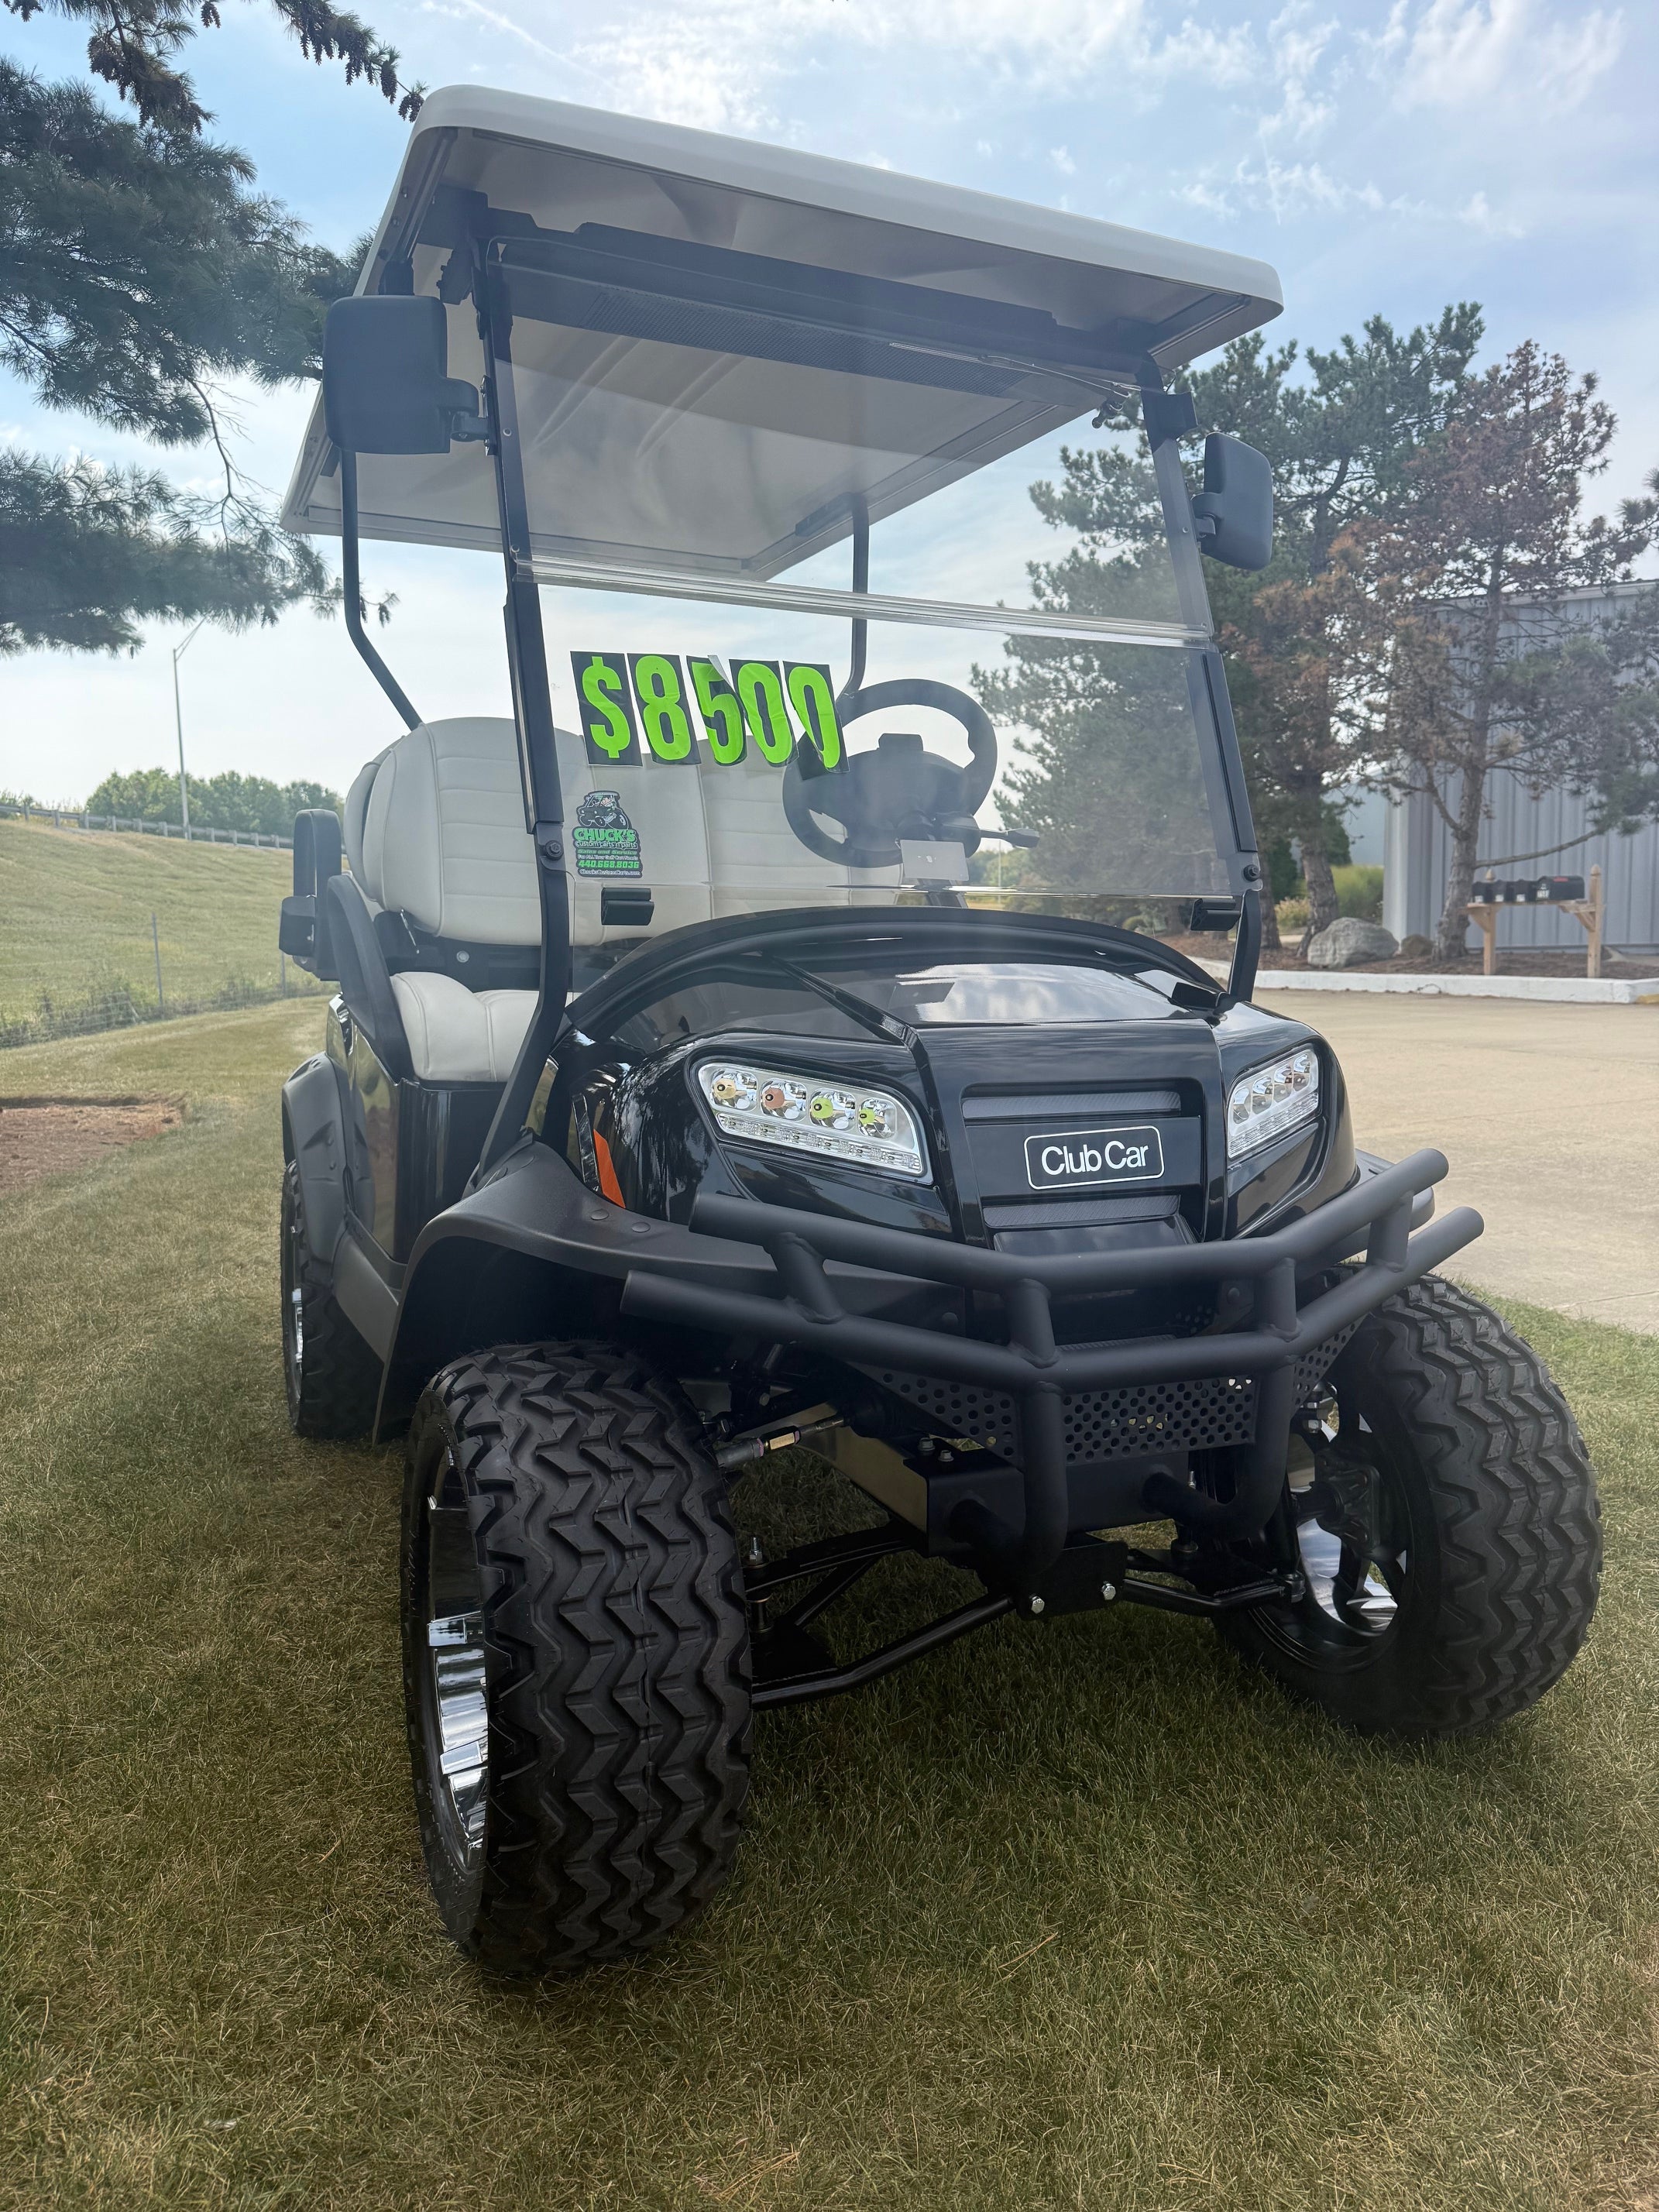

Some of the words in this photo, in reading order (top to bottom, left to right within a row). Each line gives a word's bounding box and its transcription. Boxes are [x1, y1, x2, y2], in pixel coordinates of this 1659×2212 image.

[581, 655, 840, 768] $8500
[574, 828, 637, 842] CHUCK'S
[579, 860, 640, 869] 440.668.8036
[1041, 1144, 1102, 1176] Club
[1104, 1140, 1149, 1170] Car
